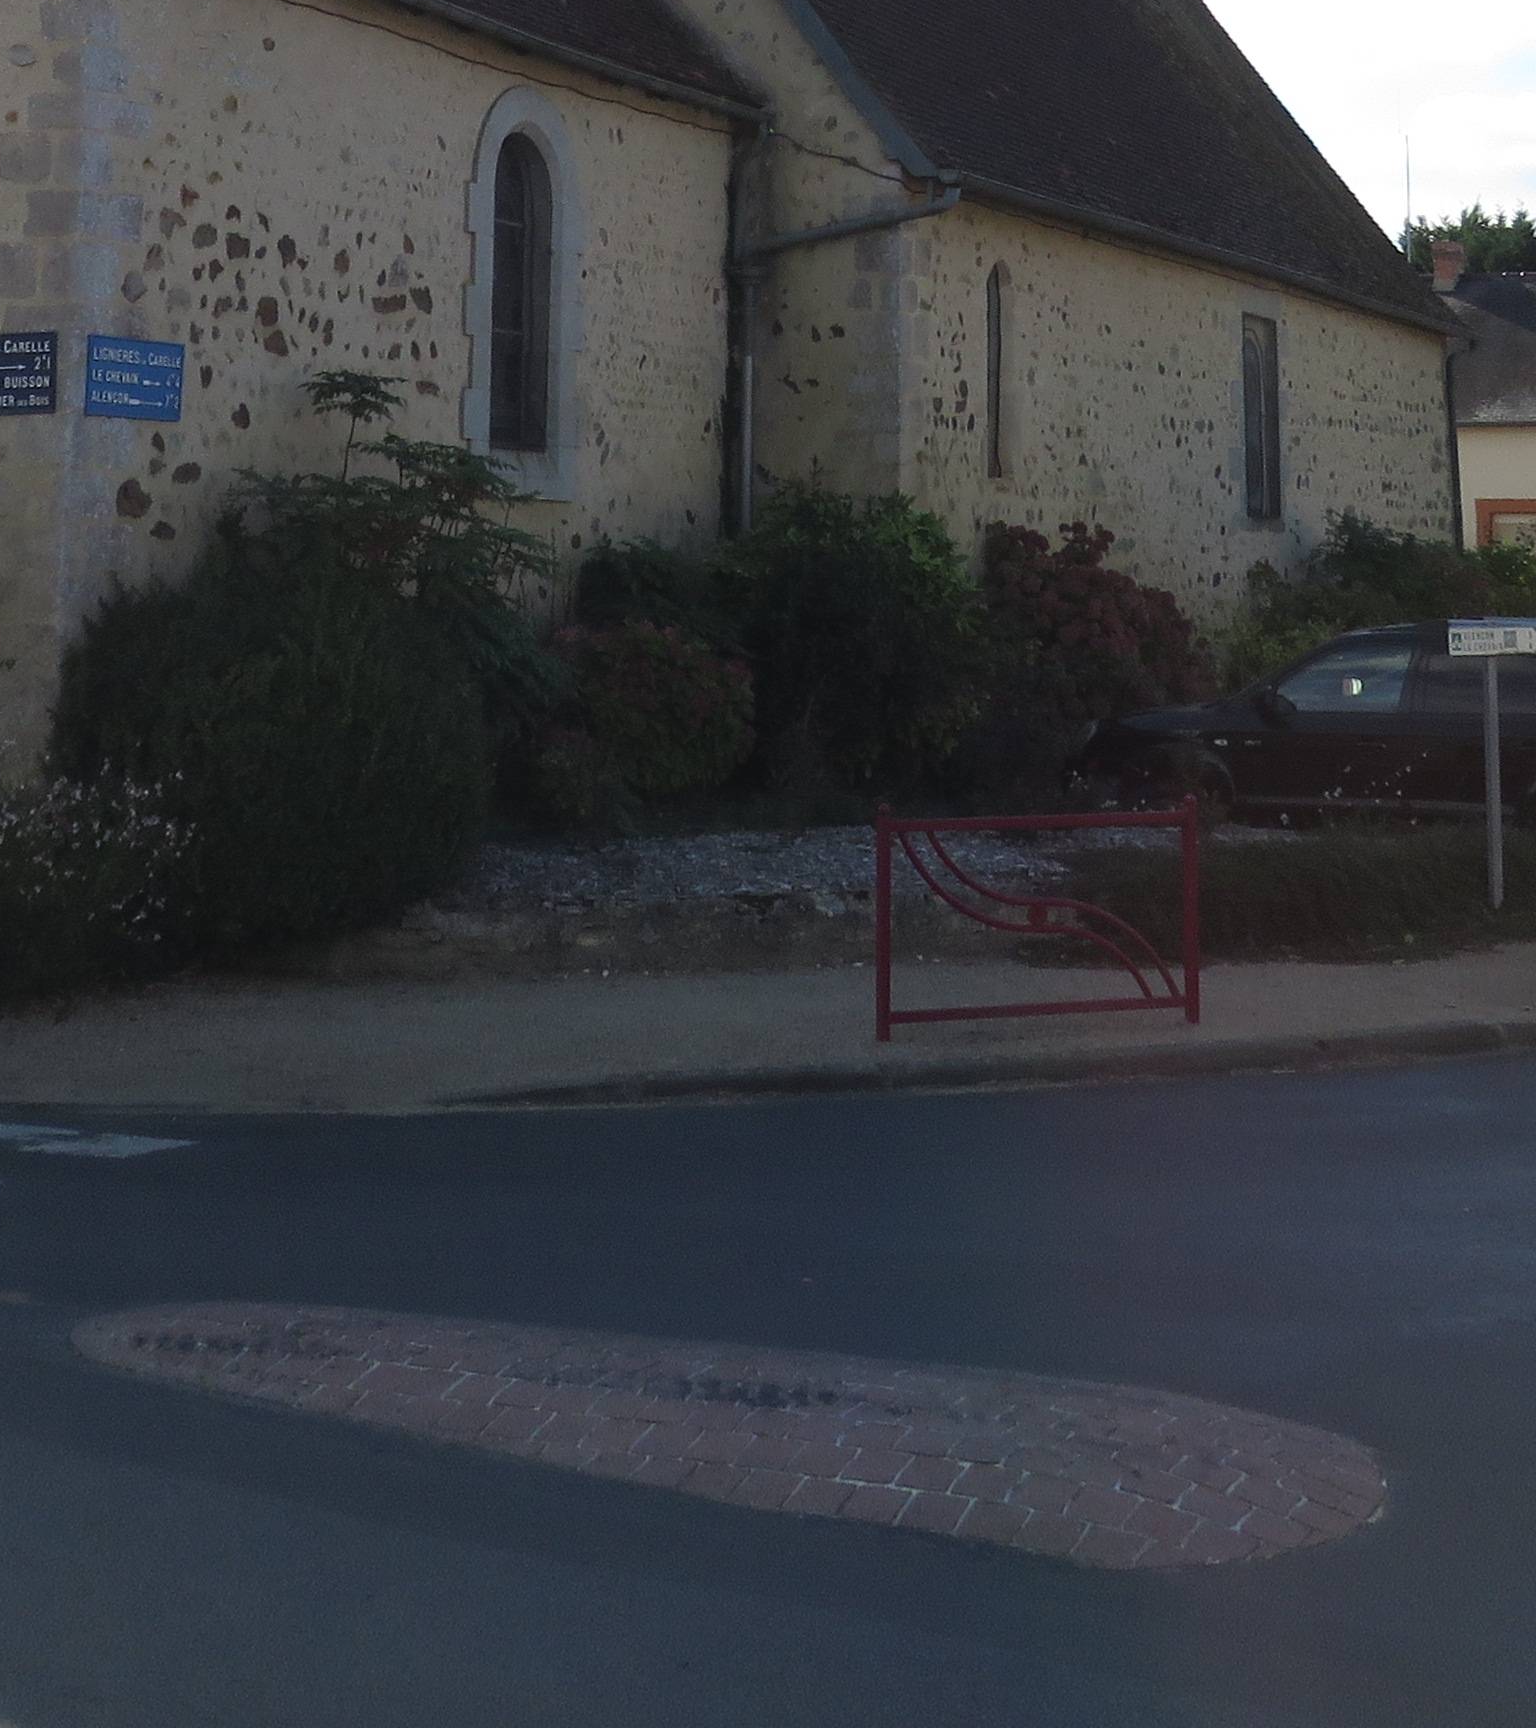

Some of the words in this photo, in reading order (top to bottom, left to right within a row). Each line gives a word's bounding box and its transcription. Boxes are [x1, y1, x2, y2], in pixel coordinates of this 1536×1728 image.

[4, 340, 51, 353] CARELLE
[4, 375, 51, 389] BUISSON
[92, 368, 103, 382] LE
